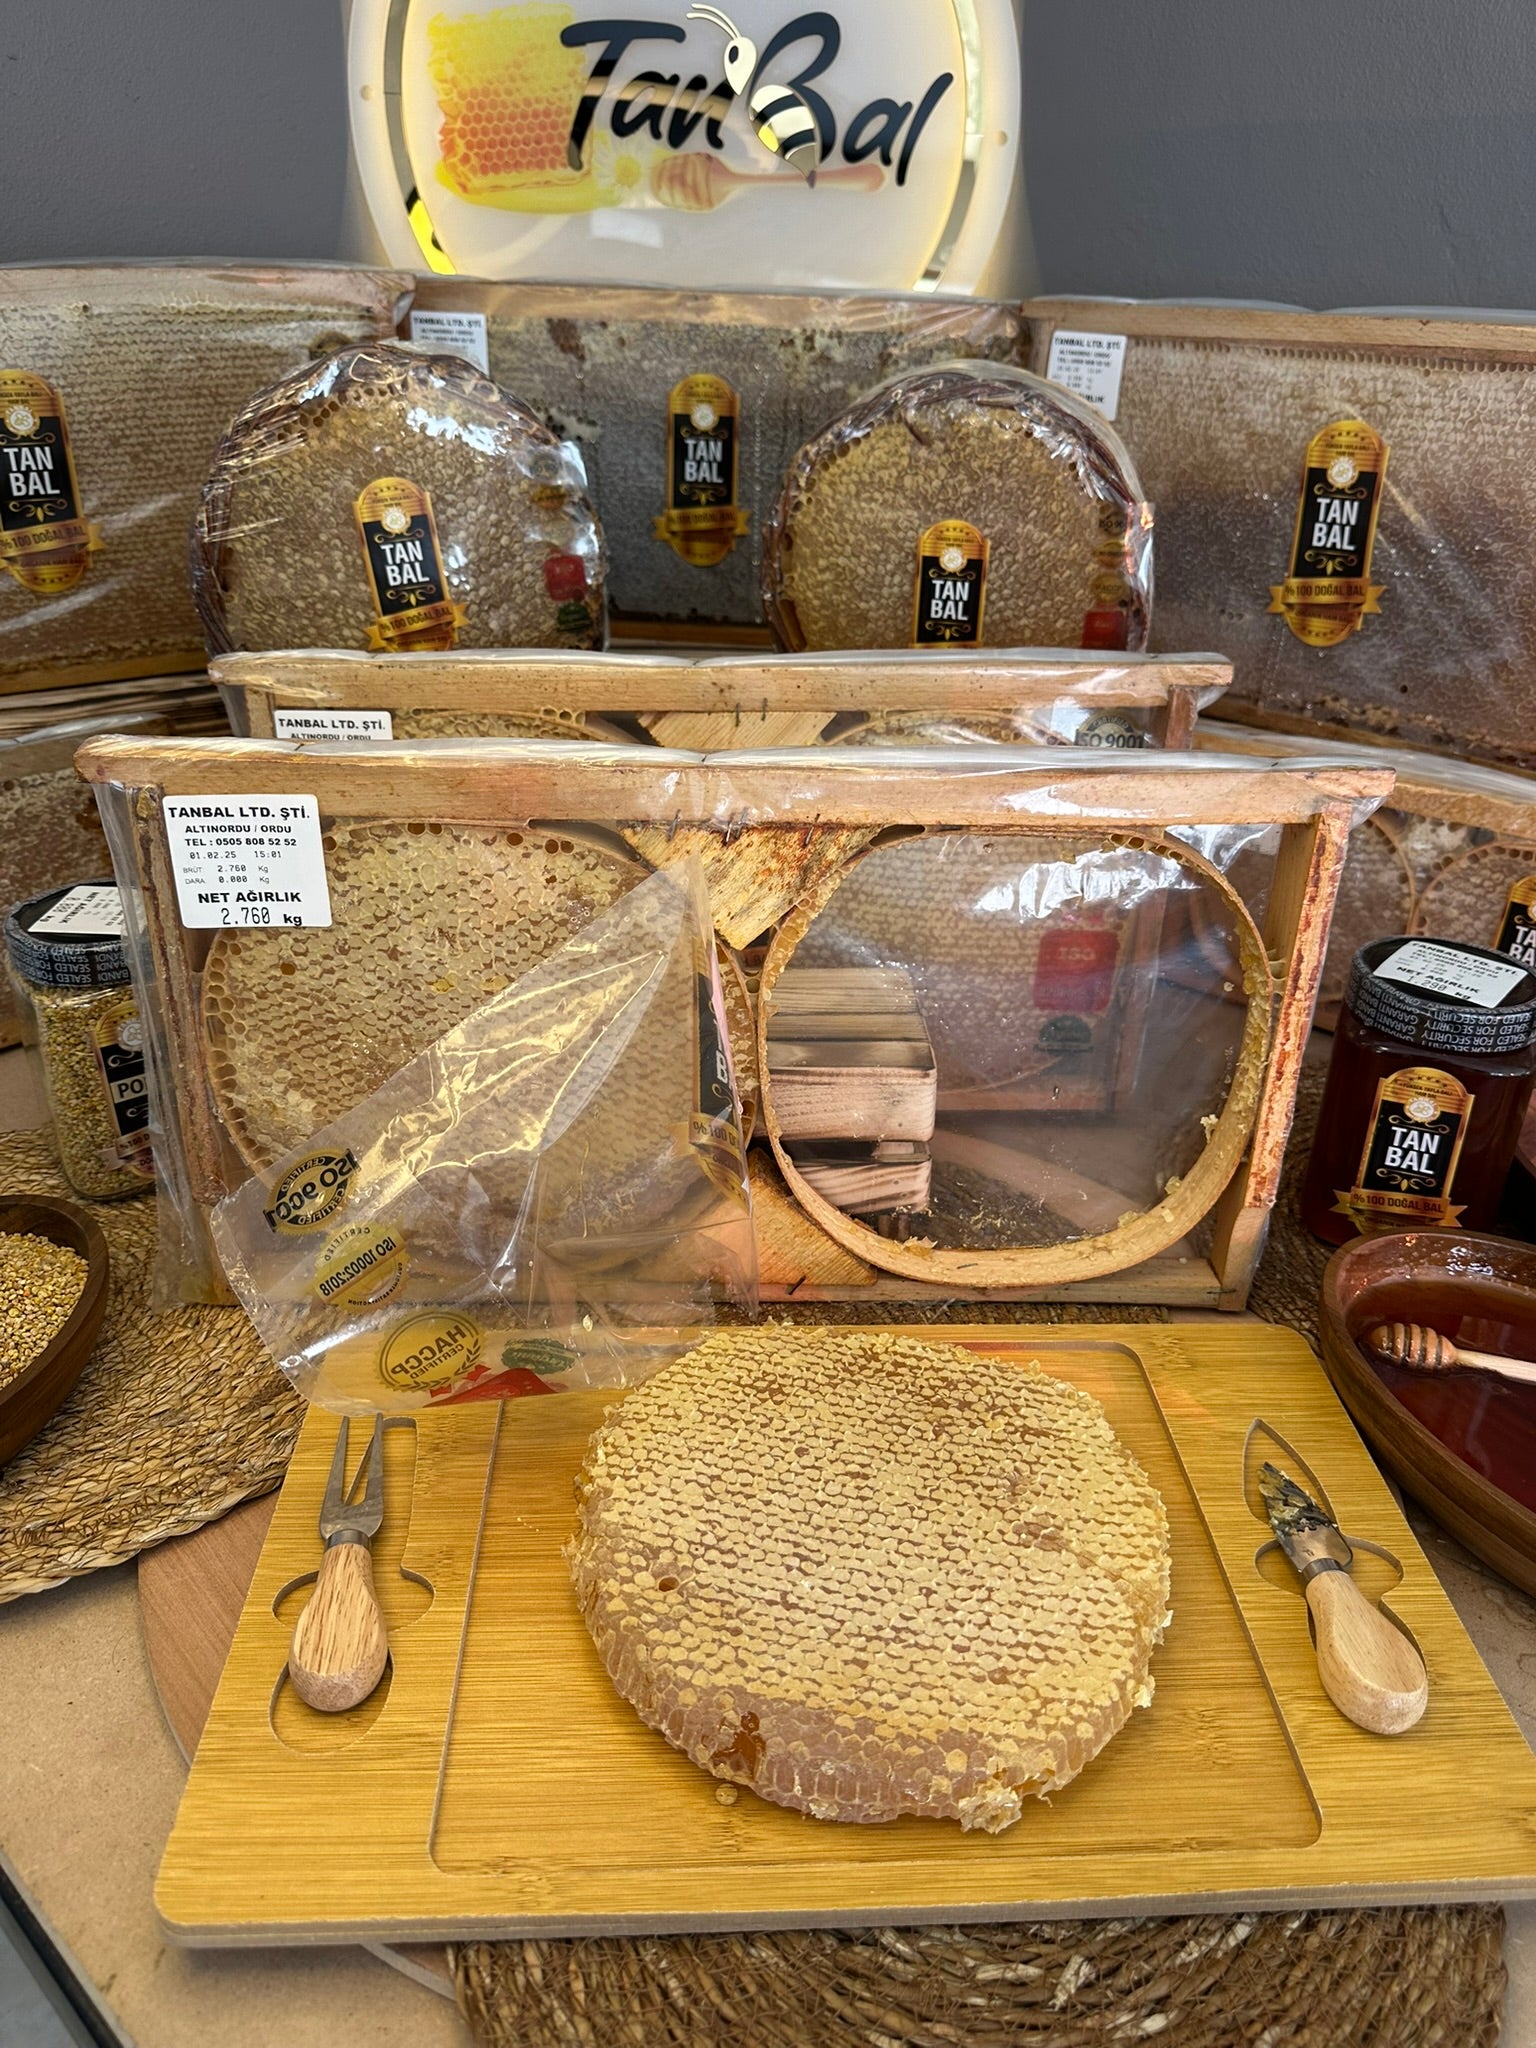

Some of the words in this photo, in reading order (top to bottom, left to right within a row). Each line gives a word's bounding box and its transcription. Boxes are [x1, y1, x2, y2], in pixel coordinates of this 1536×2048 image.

[684, 438, 723, 462] TAN
[3, 446, 54, 472] TAN
[684, 460, 725, 484] BAL
[9, 471, 61, 497] BAL
[1316, 497, 1359, 525] TAN
[1311, 523, 1357, 551] BAL
[380, 540, 424, 566] TAN
[385, 562, 431, 587] BAL
[931, 579, 970, 601] TAN
[930, 599, 969, 621] BAL
[278, 718, 328, 729] TANBAL
[331, 720, 359, 730] LTD.
[1104, 733, 1144, 749] 9001
[168, 806, 235, 819] TANBAL
[239, 806, 276, 819] LTD.
[280, 805, 311, 821] ŞTİ.
[185, 825, 251, 833] ALTINORDU
[260, 825, 292, 834] ORDU
[185, 838, 207, 847] TEL
[215, 838, 242, 846] 0505
[245, 838, 265, 846] 808
[268, 838, 281, 847] 52
[284, 838, 298, 847] 52
[189, 851, 237, 860] 01.02.25
[254, 851, 282, 859] 15:01
[217, 864, 247, 873] 2.760
[258, 865, 269, 874] Kg
[218, 876, 248, 884] 0.000
[198, 892, 230, 904] NET
[235, 890, 303, 903] AĞIRLIK
[221, 907, 271, 925] 2.760
[283, 914, 303, 926] kg
[1509, 943, 1536, 966] BA
[54, 962, 91, 972] SEALED
[1397, 966, 1421, 977] NET
[56, 973, 92, 983] SEALED
[1424, 1020, 1474, 1035] SECURITY
[1476, 1025, 1497, 1035] FOR
[1421, 1030, 1471, 1045] SECURITY
[1473, 1036, 1494, 1046] FOR
[1390, 1126, 1441, 1154] TAN
[1384, 1146, 1435, 1175] BAL
[1353, 1193, 1386, 1206] %100
[1387, 1196, 1421, 1210] DOĞAL
[1423, 1202, 1445, 1214] BAL
